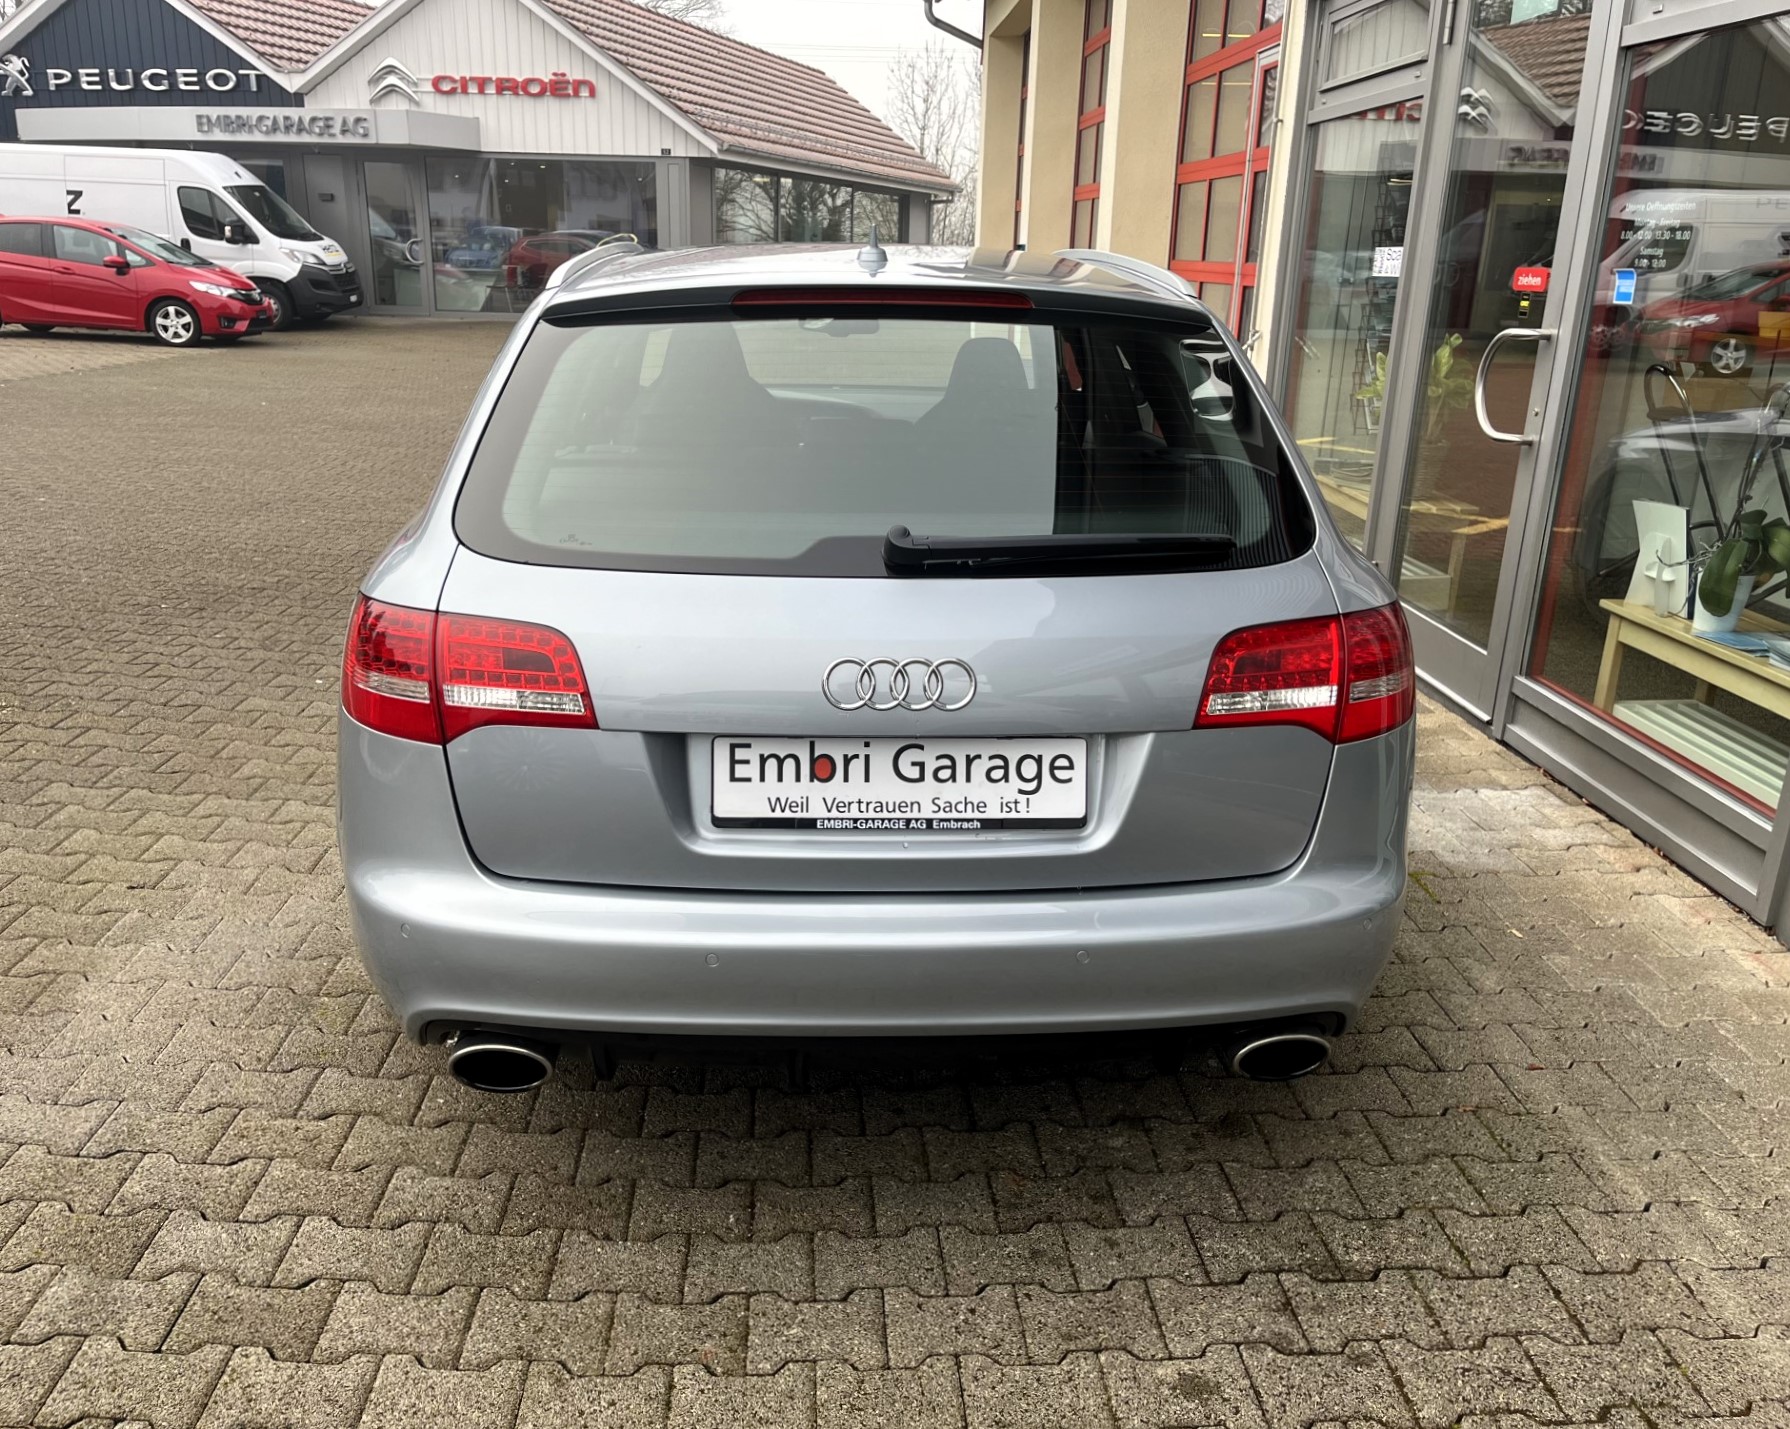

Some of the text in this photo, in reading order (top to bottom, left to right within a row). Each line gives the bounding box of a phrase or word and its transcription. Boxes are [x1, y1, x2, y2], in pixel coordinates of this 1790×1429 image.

[46, 67, 264, 92] PEUGEOT
[195, 113, 370, 138] EMBRI-GARAGE AG
[1518, 273, 1541, 286] ziehen
[729, 741, 1075, 796] Embri Garage
[767, 797, 809, 814] Weil
[822, 797, 921, 814] Vertrauen
[931, 797, 987, 814] Sache
[816, 819, 981, 830] EMBRI-GARAGE AG Embrach
